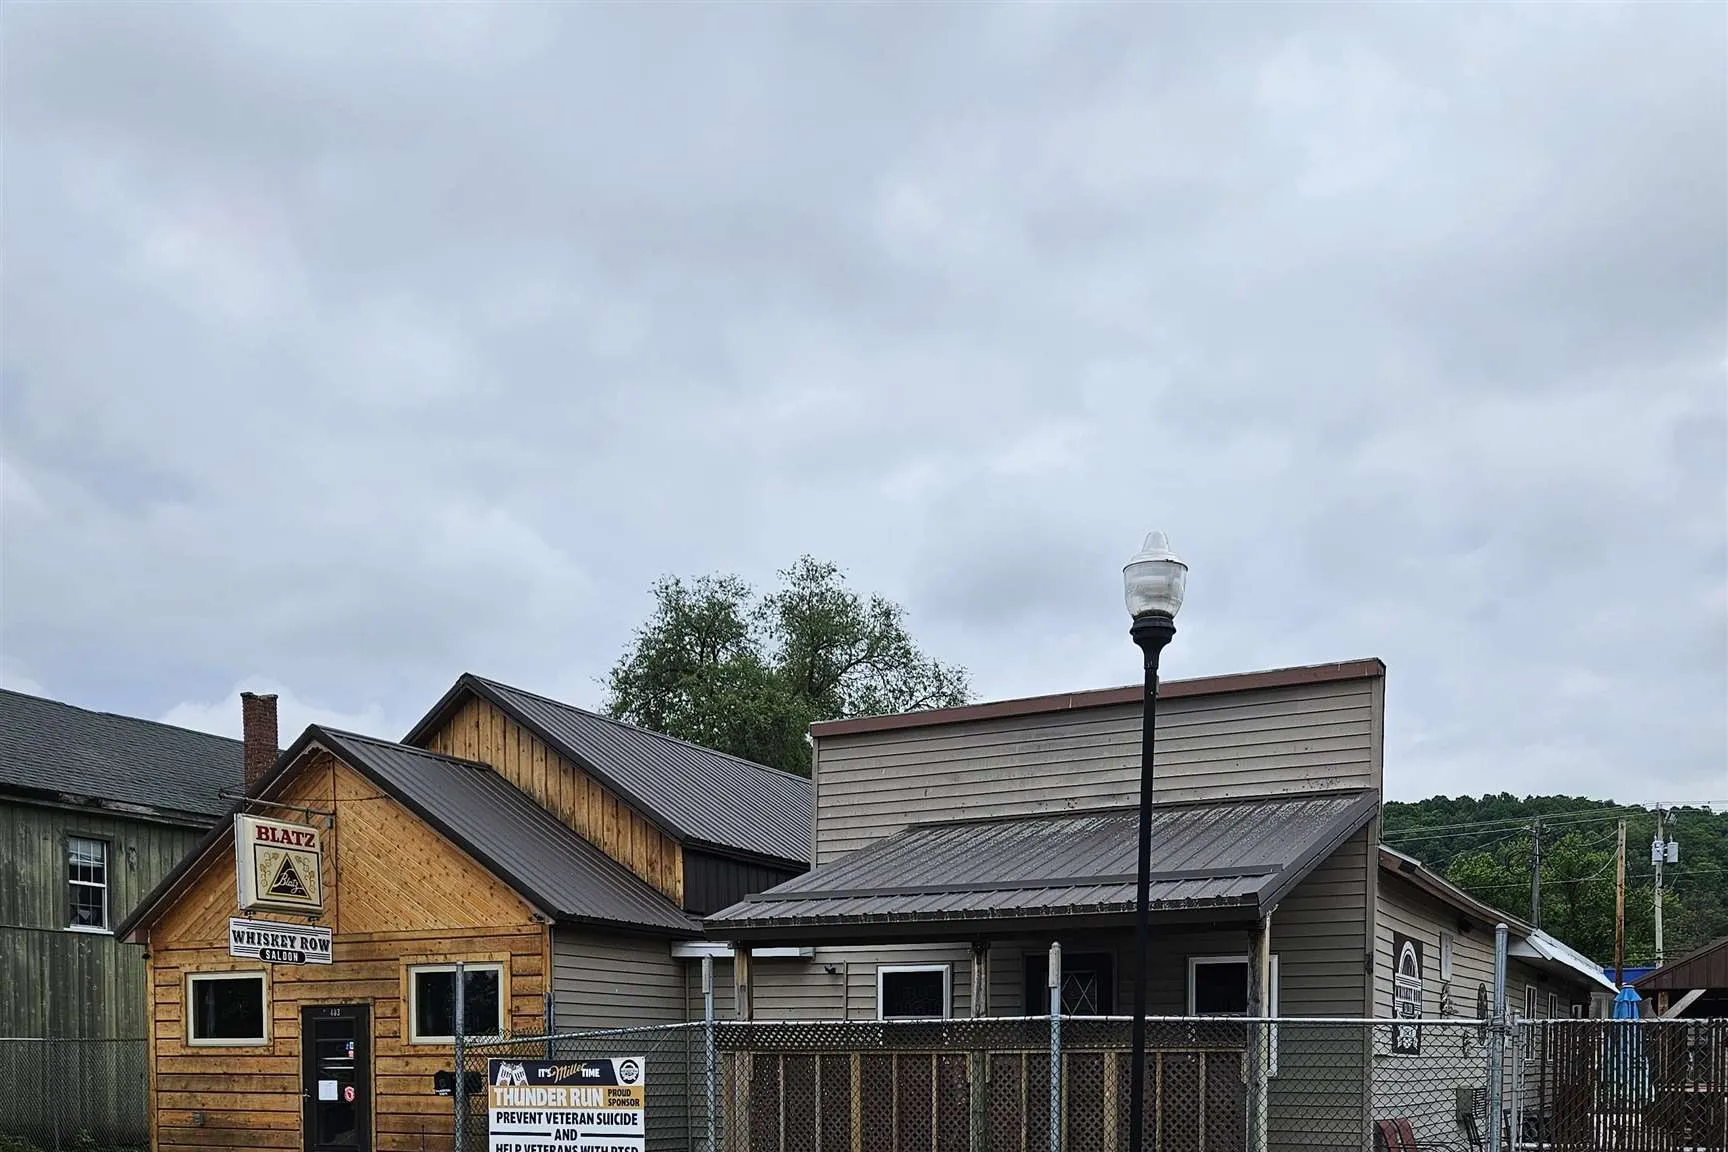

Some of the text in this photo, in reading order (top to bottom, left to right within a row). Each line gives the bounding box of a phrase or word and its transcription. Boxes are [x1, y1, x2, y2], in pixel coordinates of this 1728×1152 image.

[255, 825, 316, 848] BLATZ
[273, 868, 304, 894] Blatz
[232, 929, 330, 952] WHISKEY ROW
[265, 949, 299, 962] SALOON
[538, 1062, 601, 1084] IT'S Miller TIME
[493, 1087, 605, 1108] THUNDER RUN
[607, 1088, 632, 1097] PROUD
[607, 1097, 640, 1107] SPONSOR
[496, 1111, 638, 1126] PREVENT VETERAN SUICIDE
[554, 1128, 578, 1141] AND
